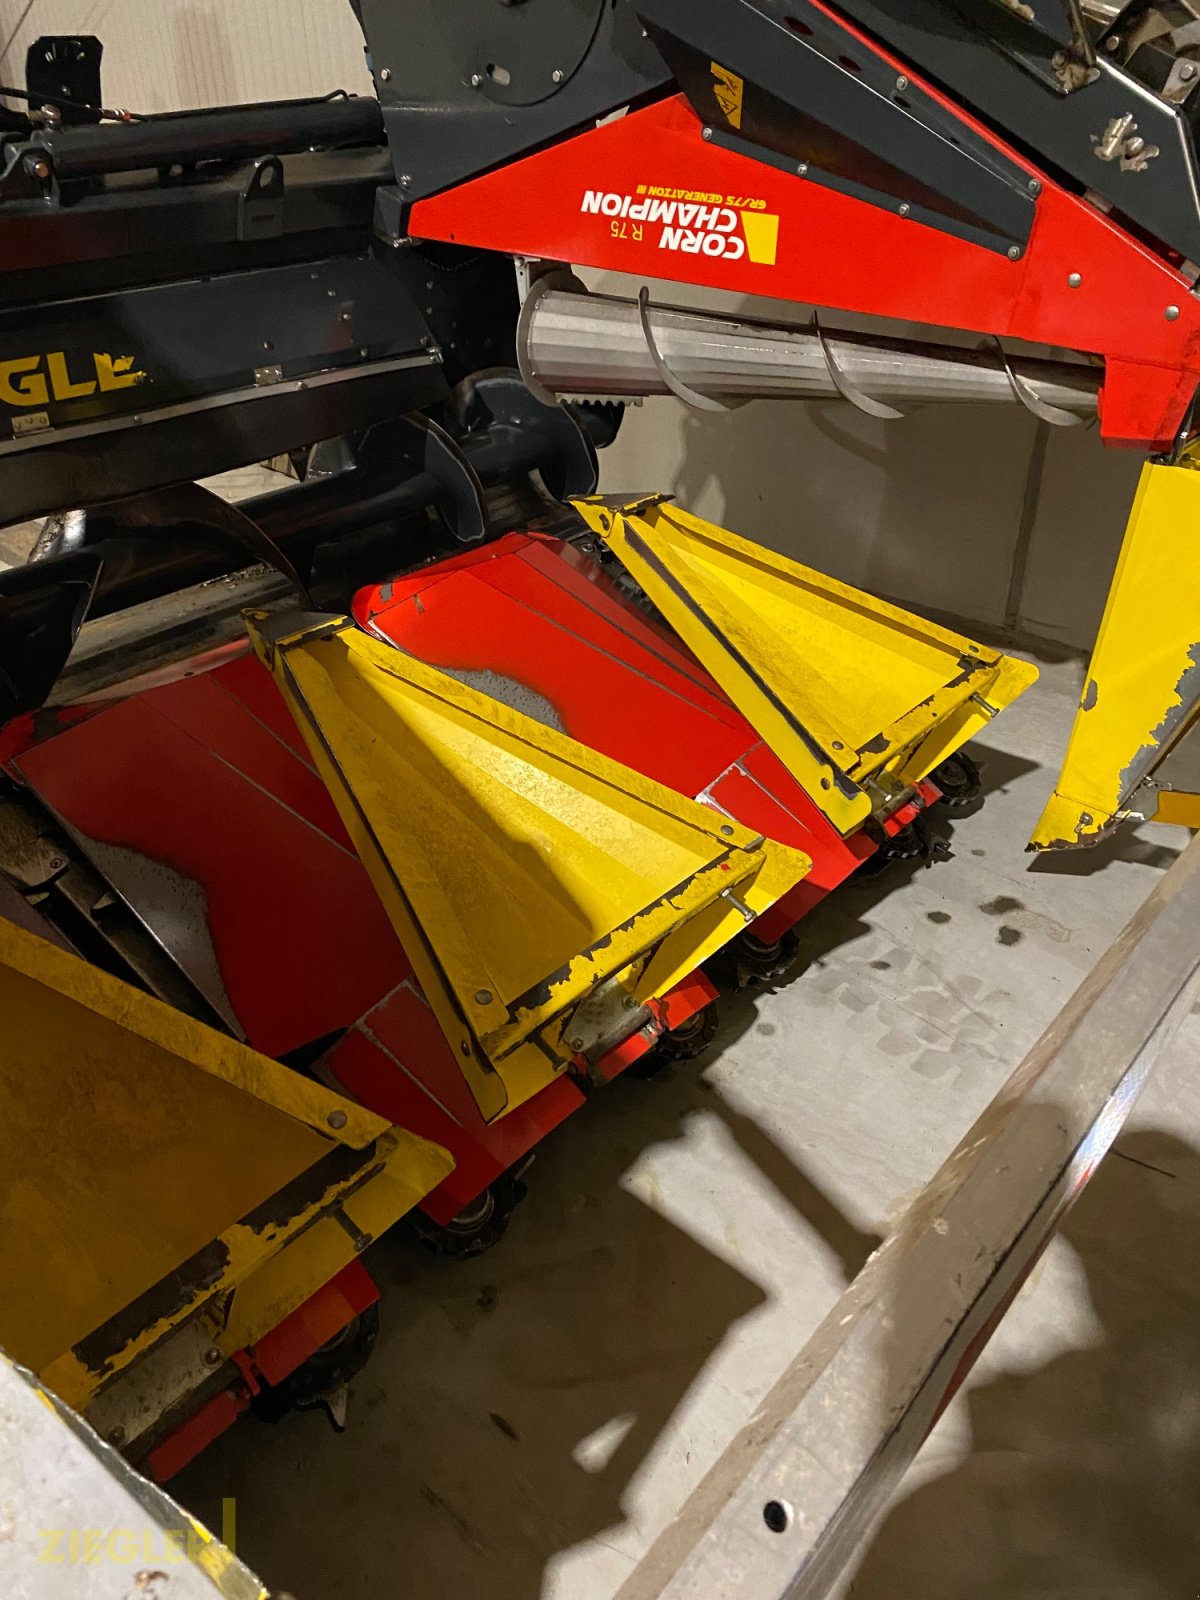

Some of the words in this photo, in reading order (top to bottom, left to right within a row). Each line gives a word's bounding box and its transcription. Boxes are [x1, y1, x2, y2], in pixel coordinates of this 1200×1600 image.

[648, 185, 724, 204] GENERATION
[580, 190, 738, 233] CHAMPION
[610, 220, 628, 239] 75
[632, 224, 643, 242] R
[659, 226, 745, 260] CORN
